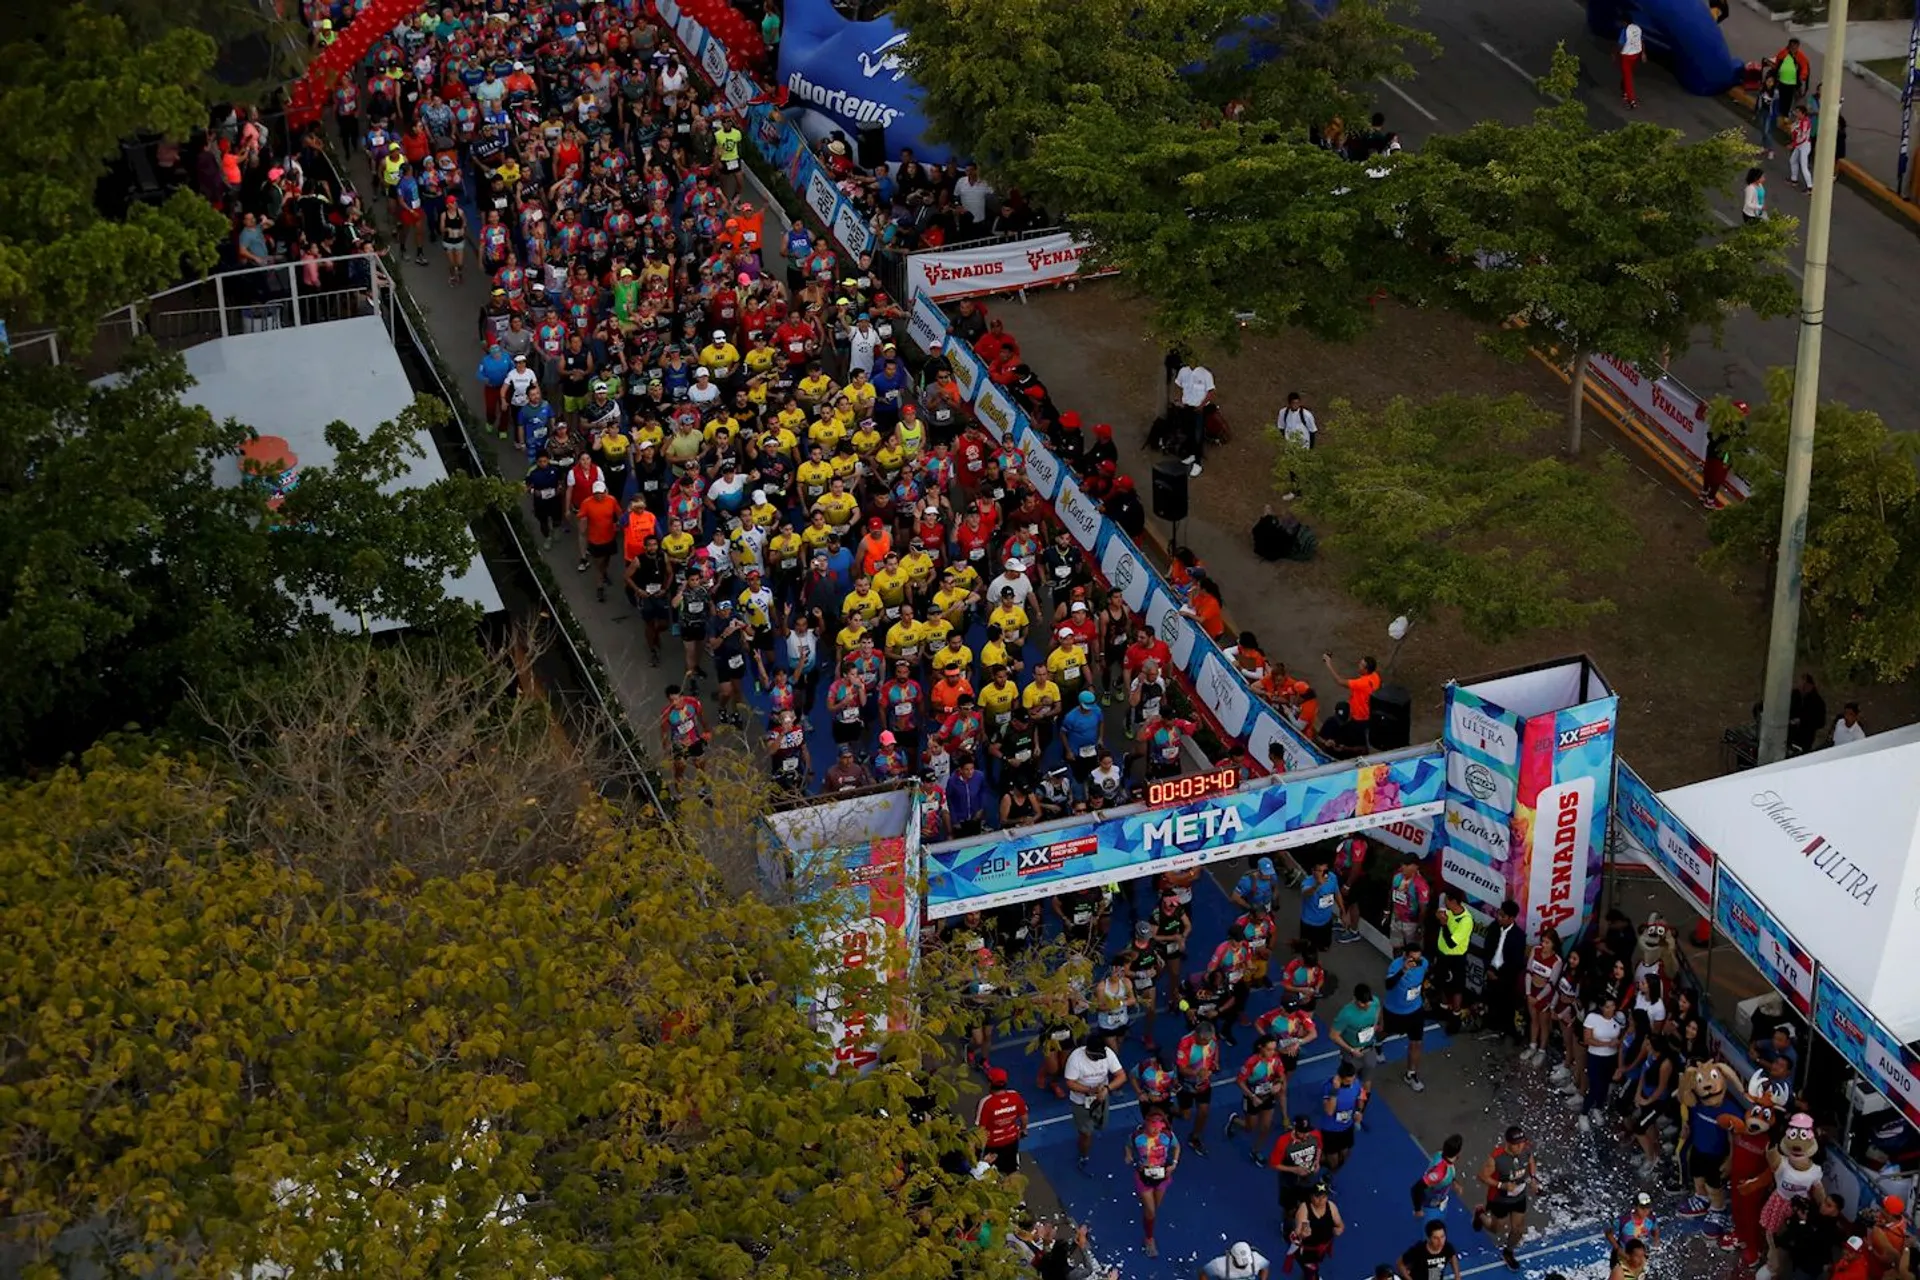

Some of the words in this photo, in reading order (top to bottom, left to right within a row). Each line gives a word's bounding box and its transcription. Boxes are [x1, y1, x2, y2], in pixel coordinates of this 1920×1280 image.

[924, 262, 1004, 287] VENADOS
[1652, 382, 1694, 434] VENADOS
[1462, 716, 1505, 747] ULTRA
[1559, 729, 1580, 746] XX
[1149, 769, 1235, 804] 00:03:40
[1143, 806, 1245, 851] META
[1019, 847, 1050, 869] XX
[1535, 791, 1579, 937] VENADOS
[1668, 838, 1701, 876] JUECES
[1444, 860, 1501, 893] dportenis
[1814, 845, 1878, 906] ULTRA
[1775, 952, 1798, 982] TYR
[1879, 1057, 1911, 1092] AUDIO
